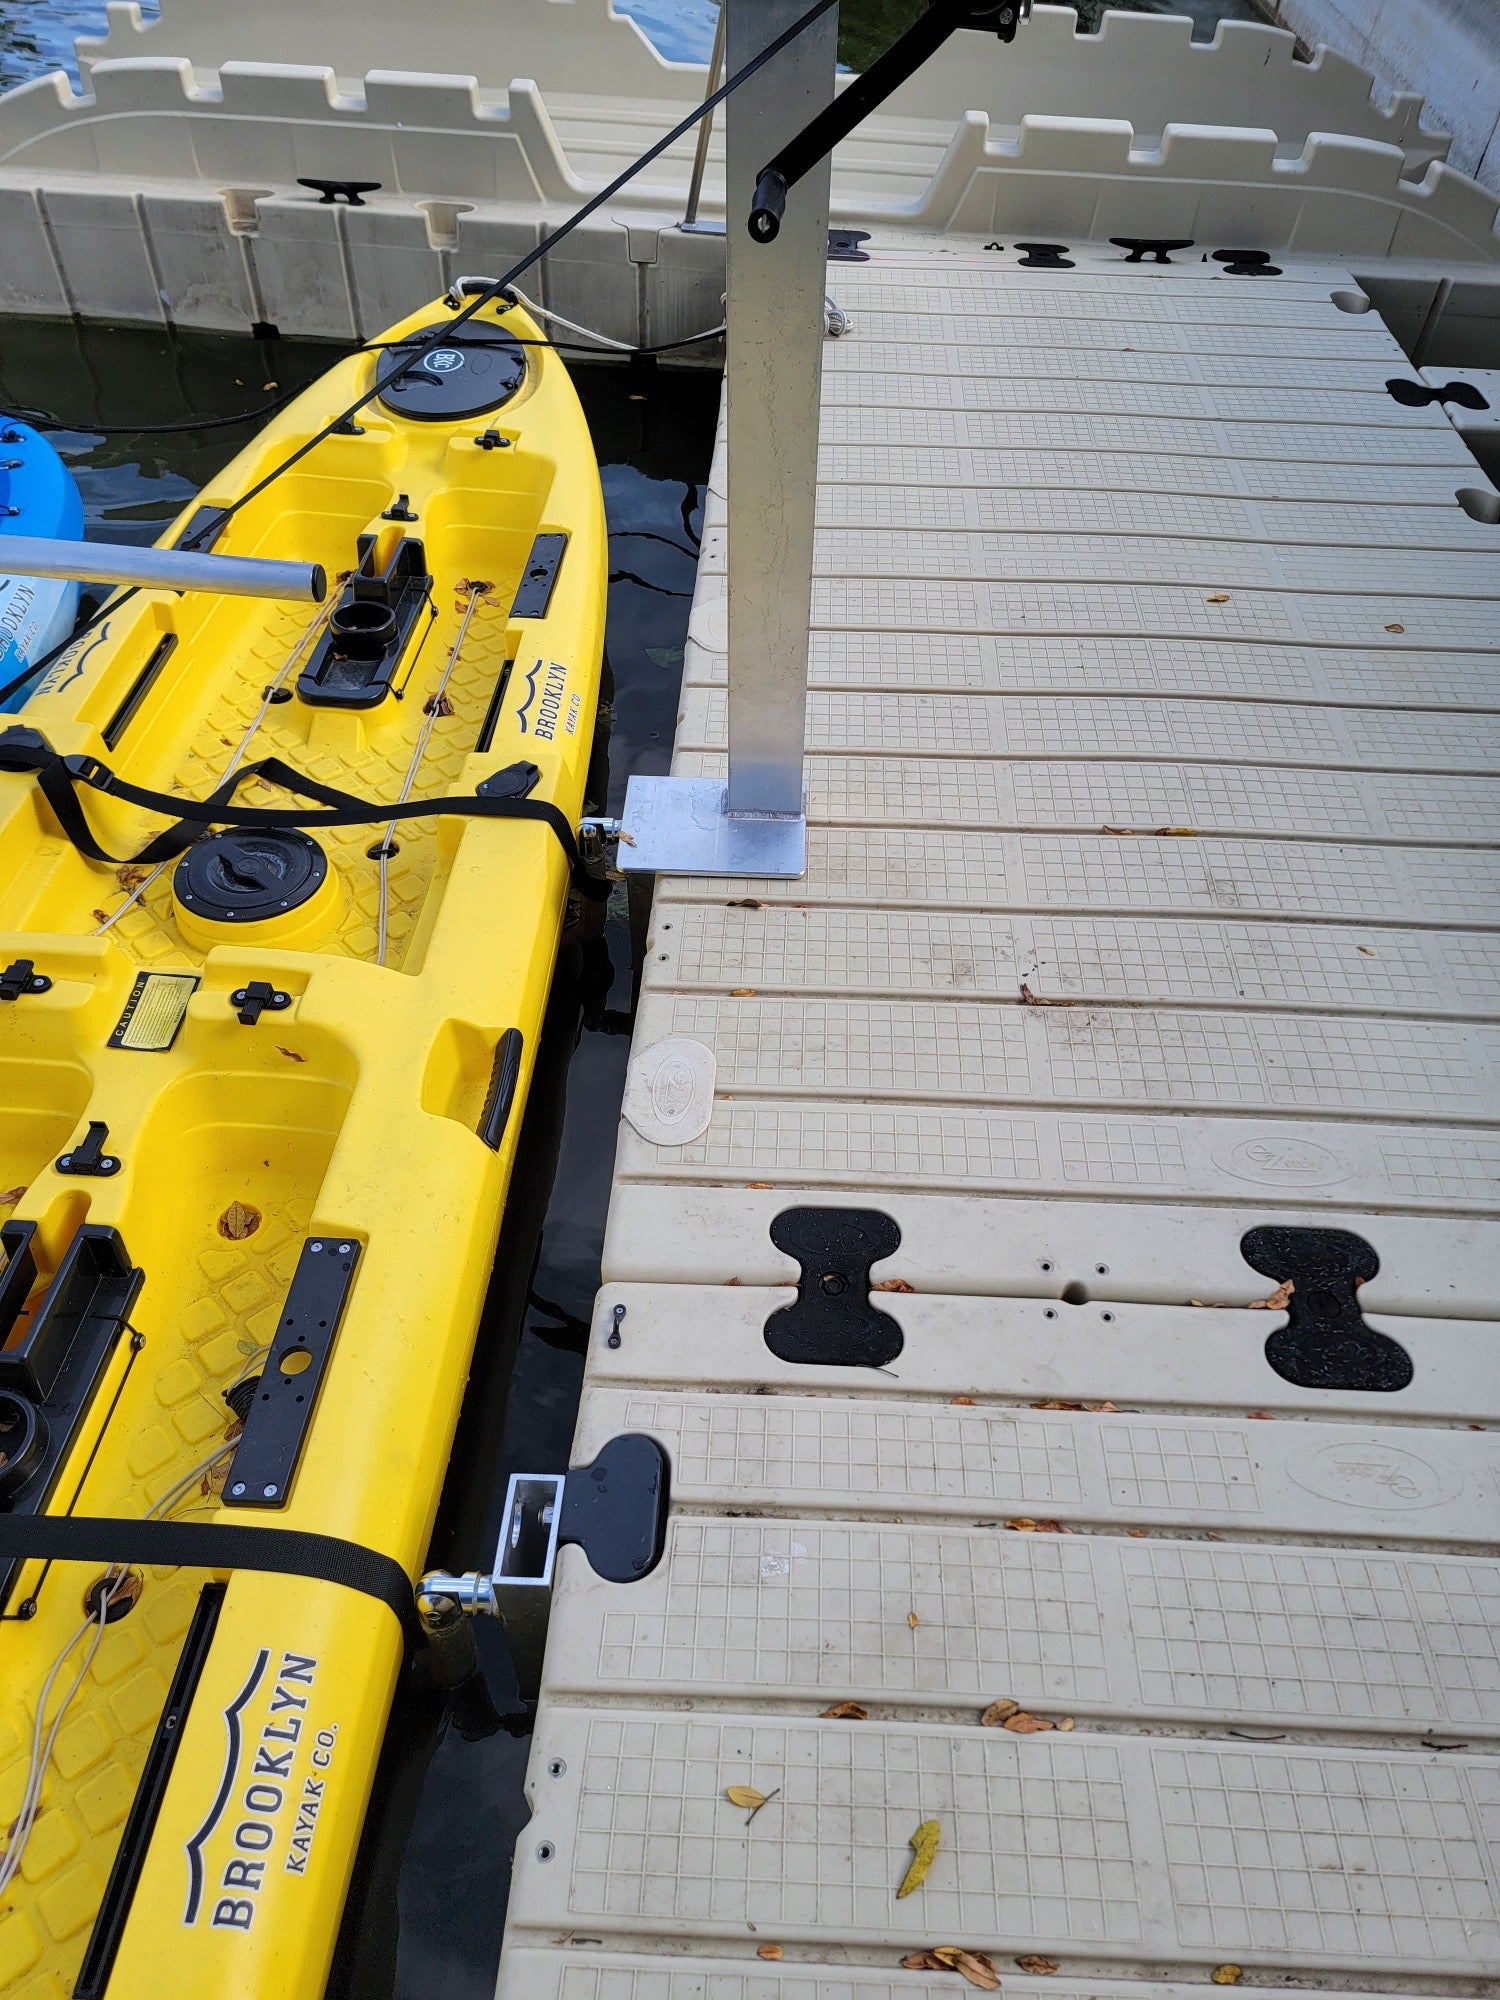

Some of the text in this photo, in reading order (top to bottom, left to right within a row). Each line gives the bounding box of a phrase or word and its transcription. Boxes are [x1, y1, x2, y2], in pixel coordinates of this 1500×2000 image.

[433, 353, 456, 369] BKC
[534, 662, 568, 741] BROOKLYN
[565, 706, 578, 736] KAYAK
[115, 981, 145, 1037] CAUTION
[212, 1651, 318, 1931] BROOKLYN
[286, 1723, 339, 1874] KAYAK CO.
